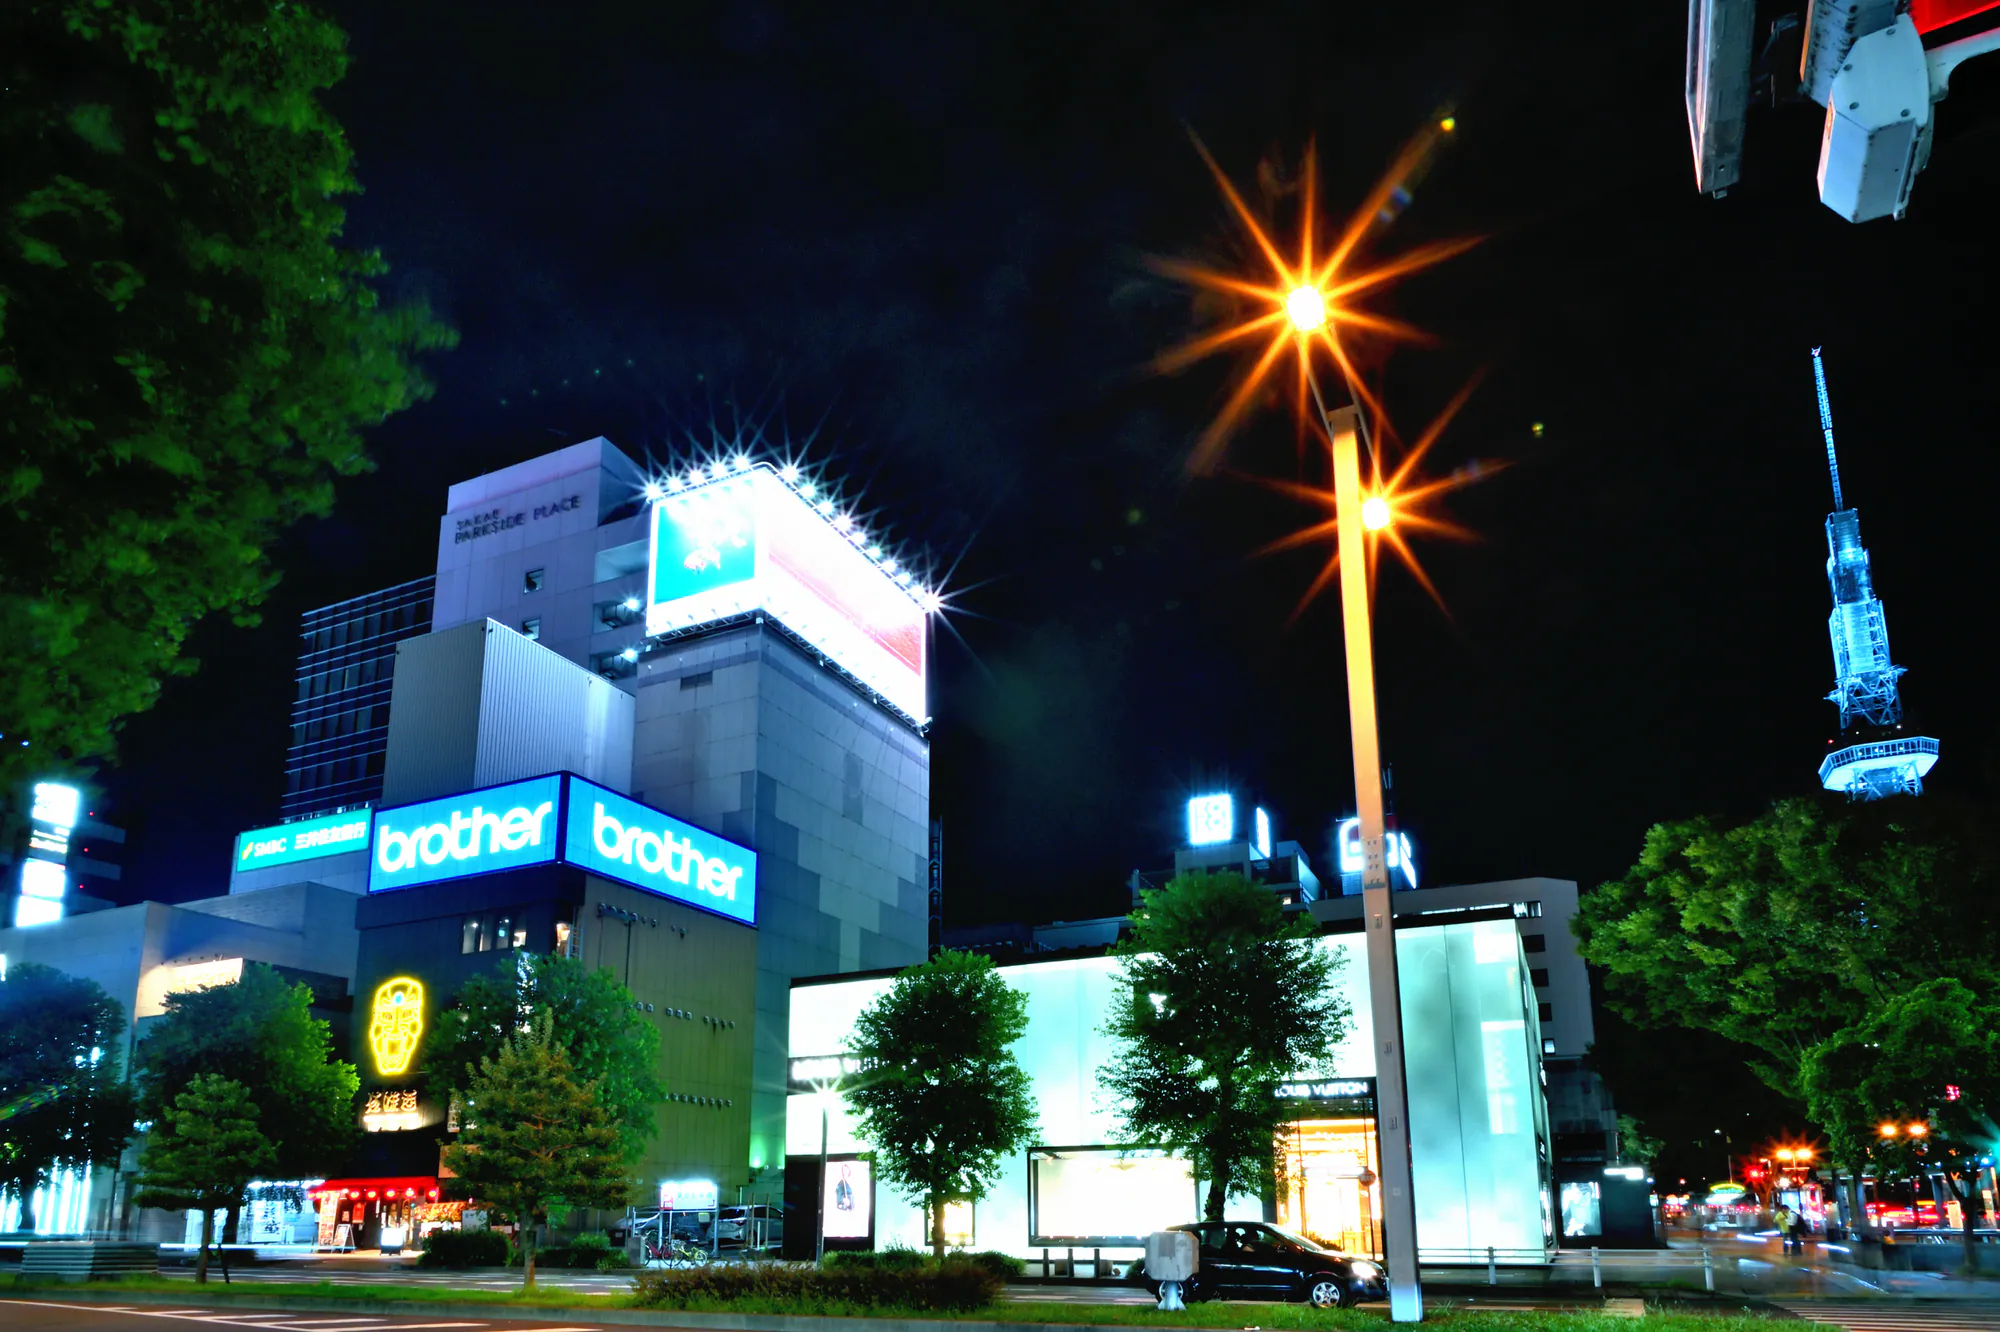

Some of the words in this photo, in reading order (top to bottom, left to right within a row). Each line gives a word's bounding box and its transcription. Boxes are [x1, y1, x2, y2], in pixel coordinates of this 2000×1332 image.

[454, 512, 527, 544] PARKSIDE
[533, 495, 580, 521] PLACE
[456, 509, 501, 531] SAKAE
[253, 837, 287, 857] SMBC
[378, 802, 552, 872] brother
[594, 802, 742, 900] brother
[1311, 1081, 1369, 1097] VUITTON
